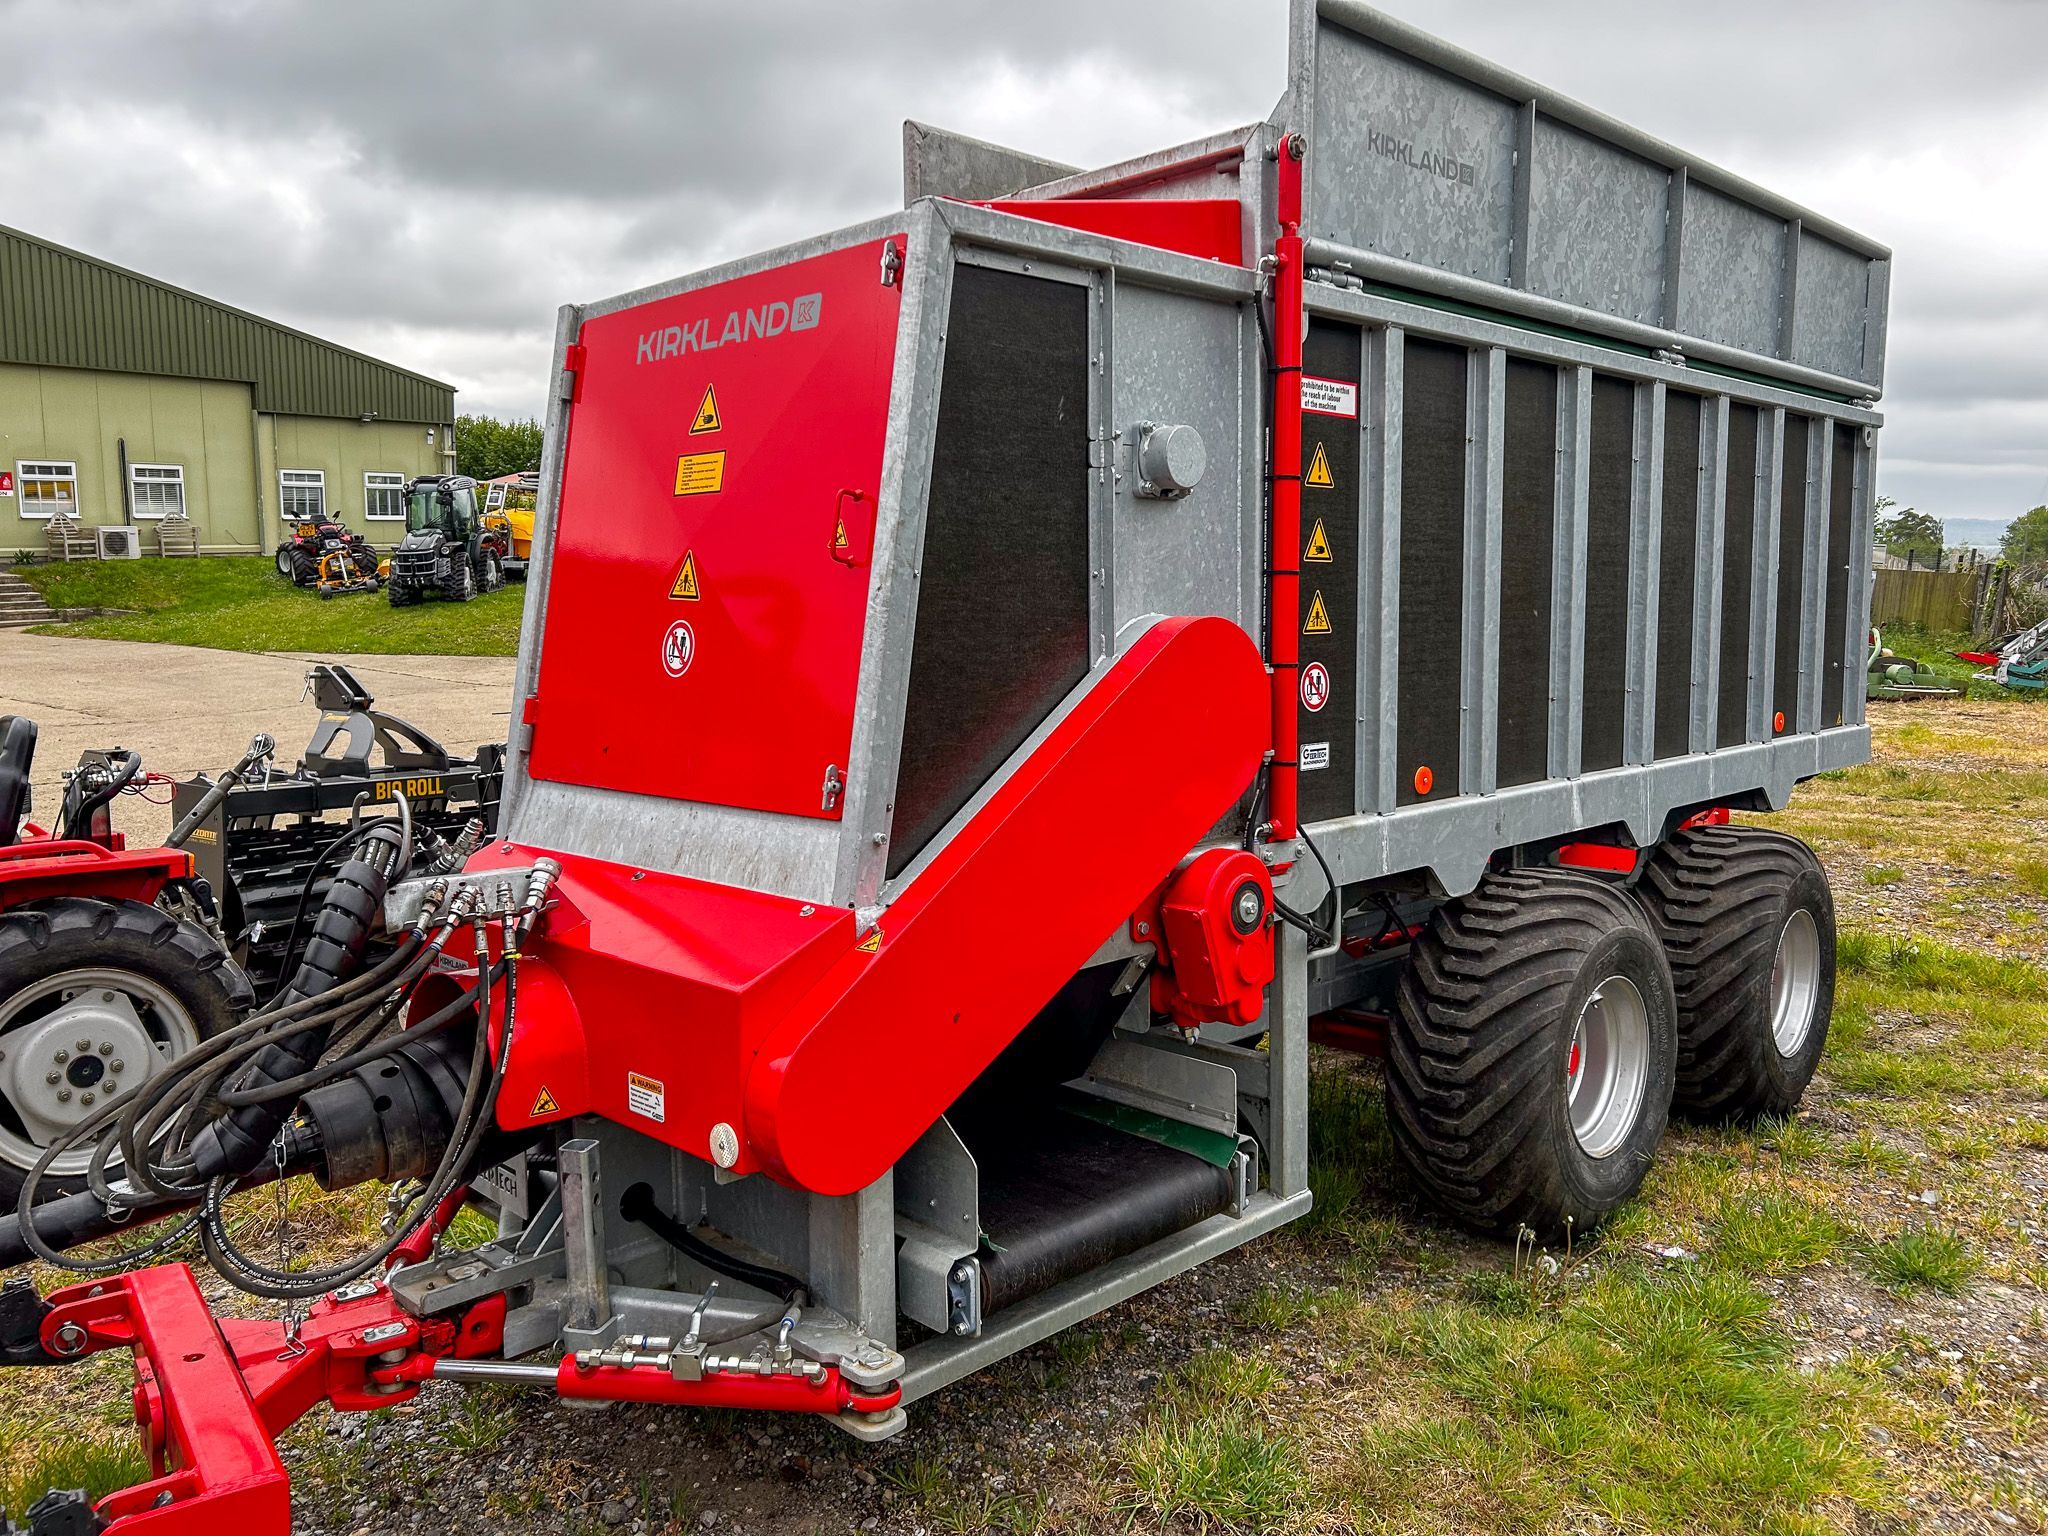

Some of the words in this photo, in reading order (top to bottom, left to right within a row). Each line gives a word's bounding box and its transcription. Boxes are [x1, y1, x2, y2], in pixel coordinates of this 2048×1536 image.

[1367, 128, 1459, 181] KIRKLAND
[636, 301, 790, 365] KIRKLAND
[1336, 386, 1350, 395] within
[1319, 402, 1337, 411] machine
[376, 780, 402, 800] BIO
[407, 777, 444, 797] ROLL
[637, 1079, 661, 1093] WARNING
